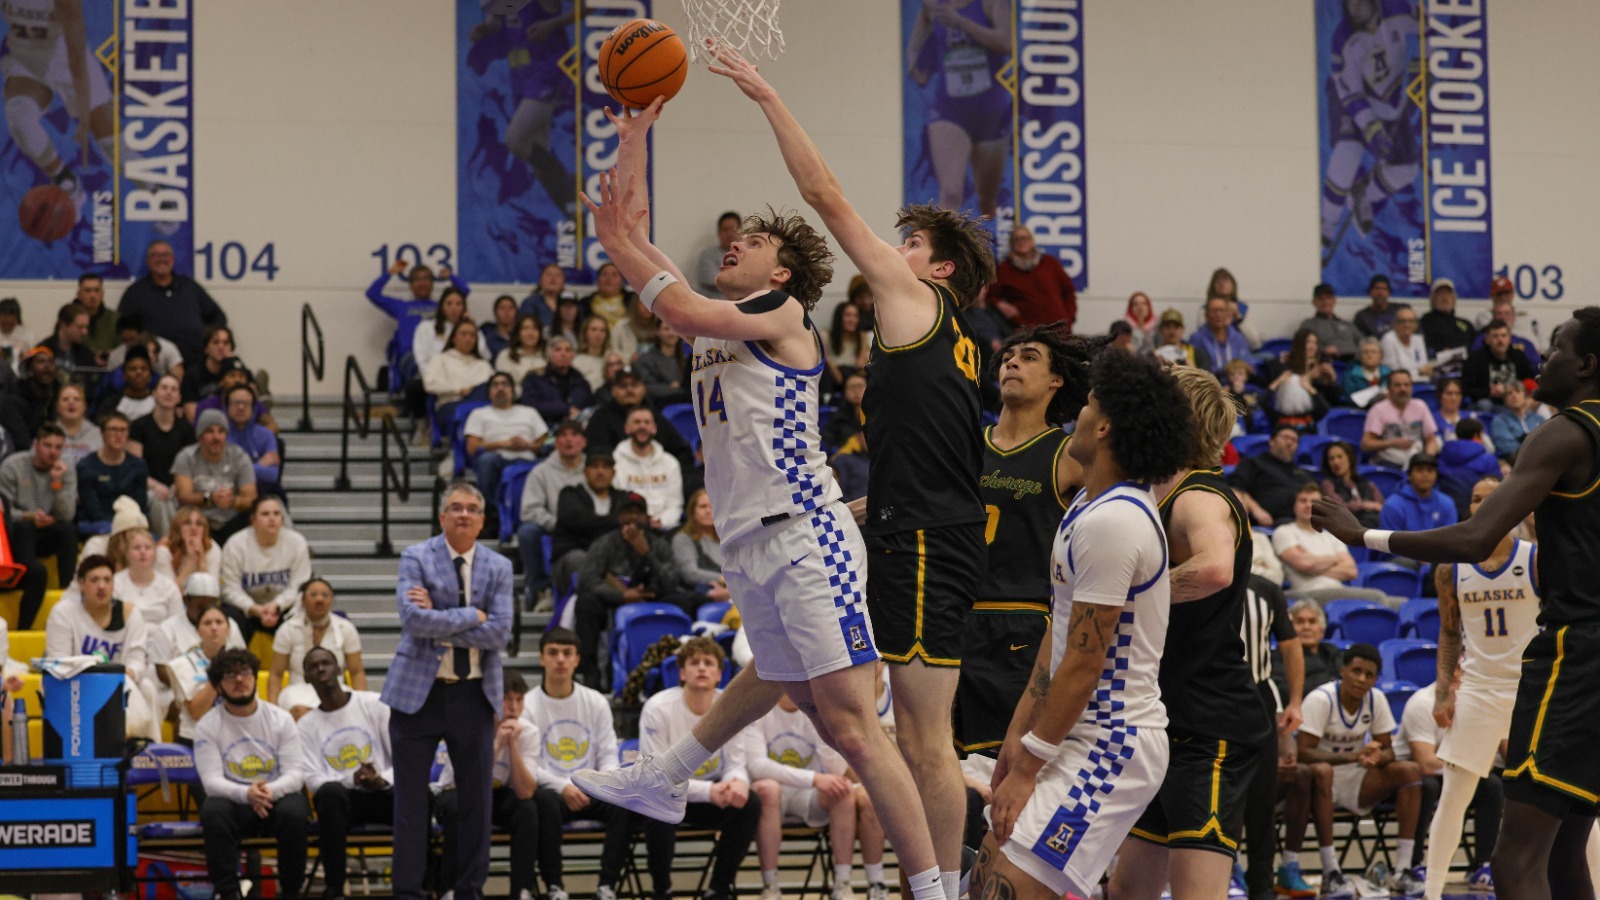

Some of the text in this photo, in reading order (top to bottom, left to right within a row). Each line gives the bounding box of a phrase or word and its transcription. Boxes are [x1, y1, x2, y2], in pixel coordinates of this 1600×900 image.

[615, 22, 669, 56] Wilson
[1432, 159, 1487, 233] ICE
[92, 190, 113, 264] WOMEN'S
[557, 220, 577, 269] MEN'S
[195, 241, 280, 281] 104
[371, 244, 455, 283] 103
[1407, 238, 1426, 284] MEN'S
[697, 375, 729, 429] 14
[979, 469, 1043, 500] chorage
[1463, 588, 1526, 604] ALASKA
[1483, 606, 1509, 638] 11
[70, 679, 81, 757] POWERADE
